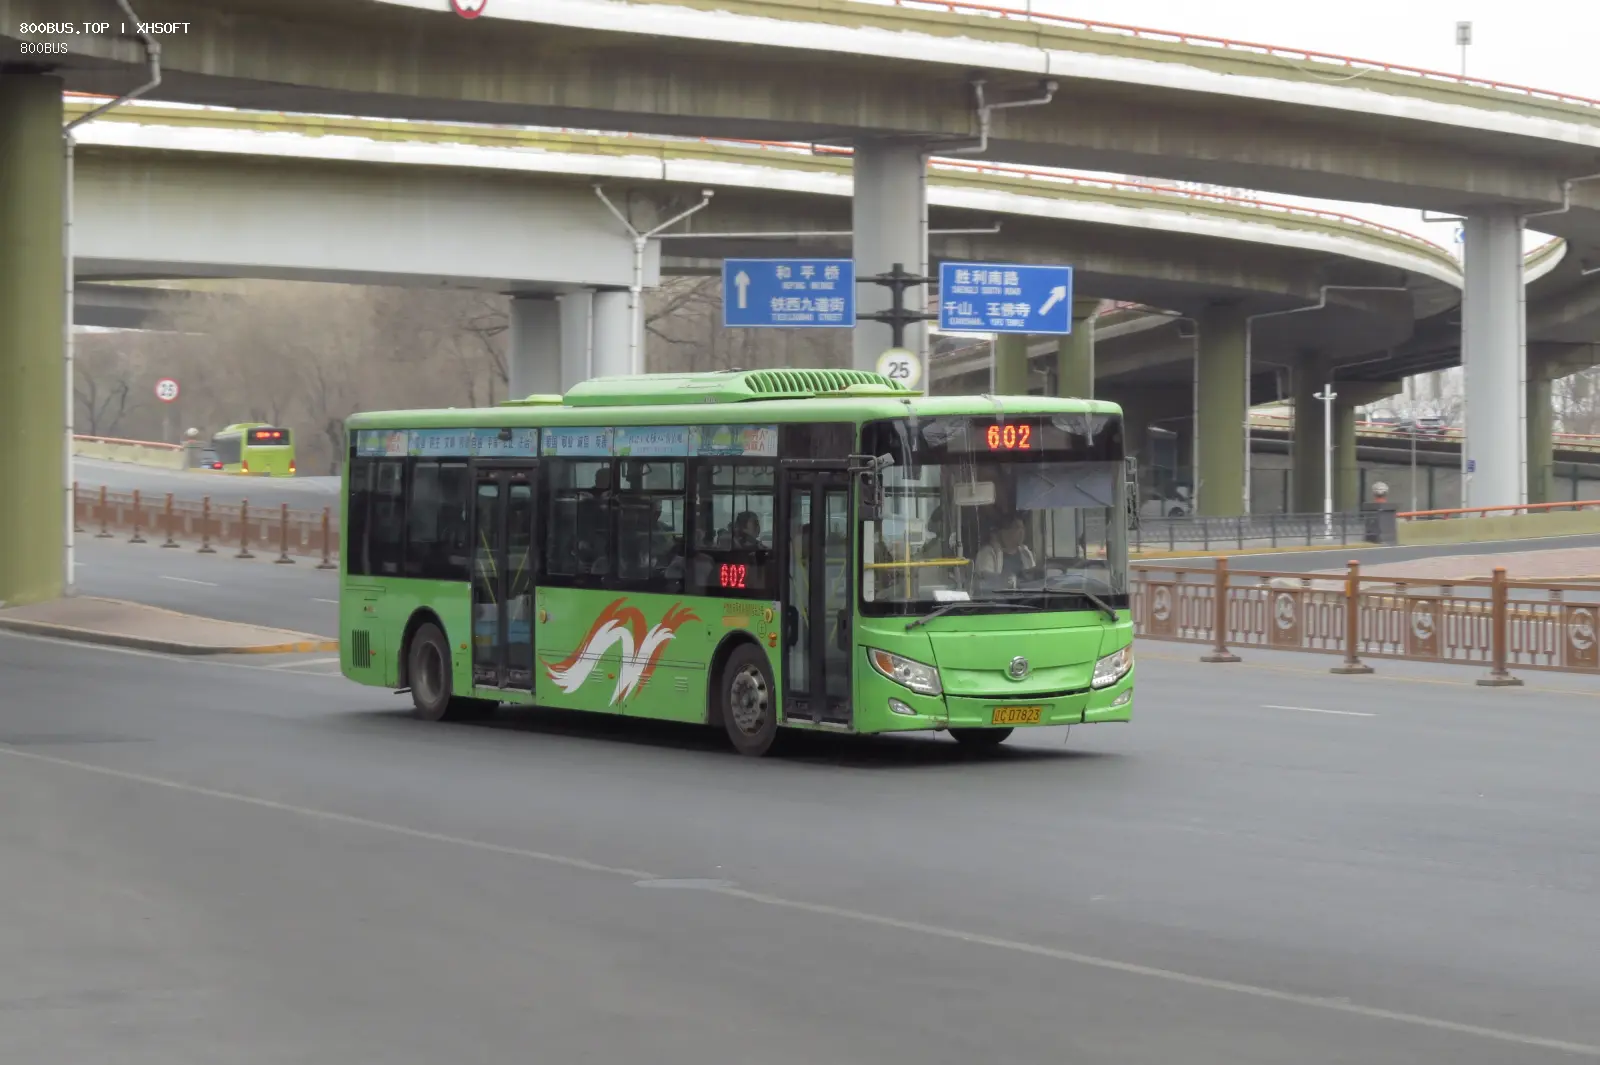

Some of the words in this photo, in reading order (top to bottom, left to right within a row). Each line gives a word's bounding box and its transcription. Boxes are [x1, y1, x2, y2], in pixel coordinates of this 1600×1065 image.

[955, 269, 1019, 286] 胜利南路
[770, 297, 845, 312] 铁西九道街
[986, 302, 1031, 317] 玉佛寺
[888, 362, 911, 379] 25
[987, 425, 1031, 449] 602
[720, 563, 746, 588] 602
